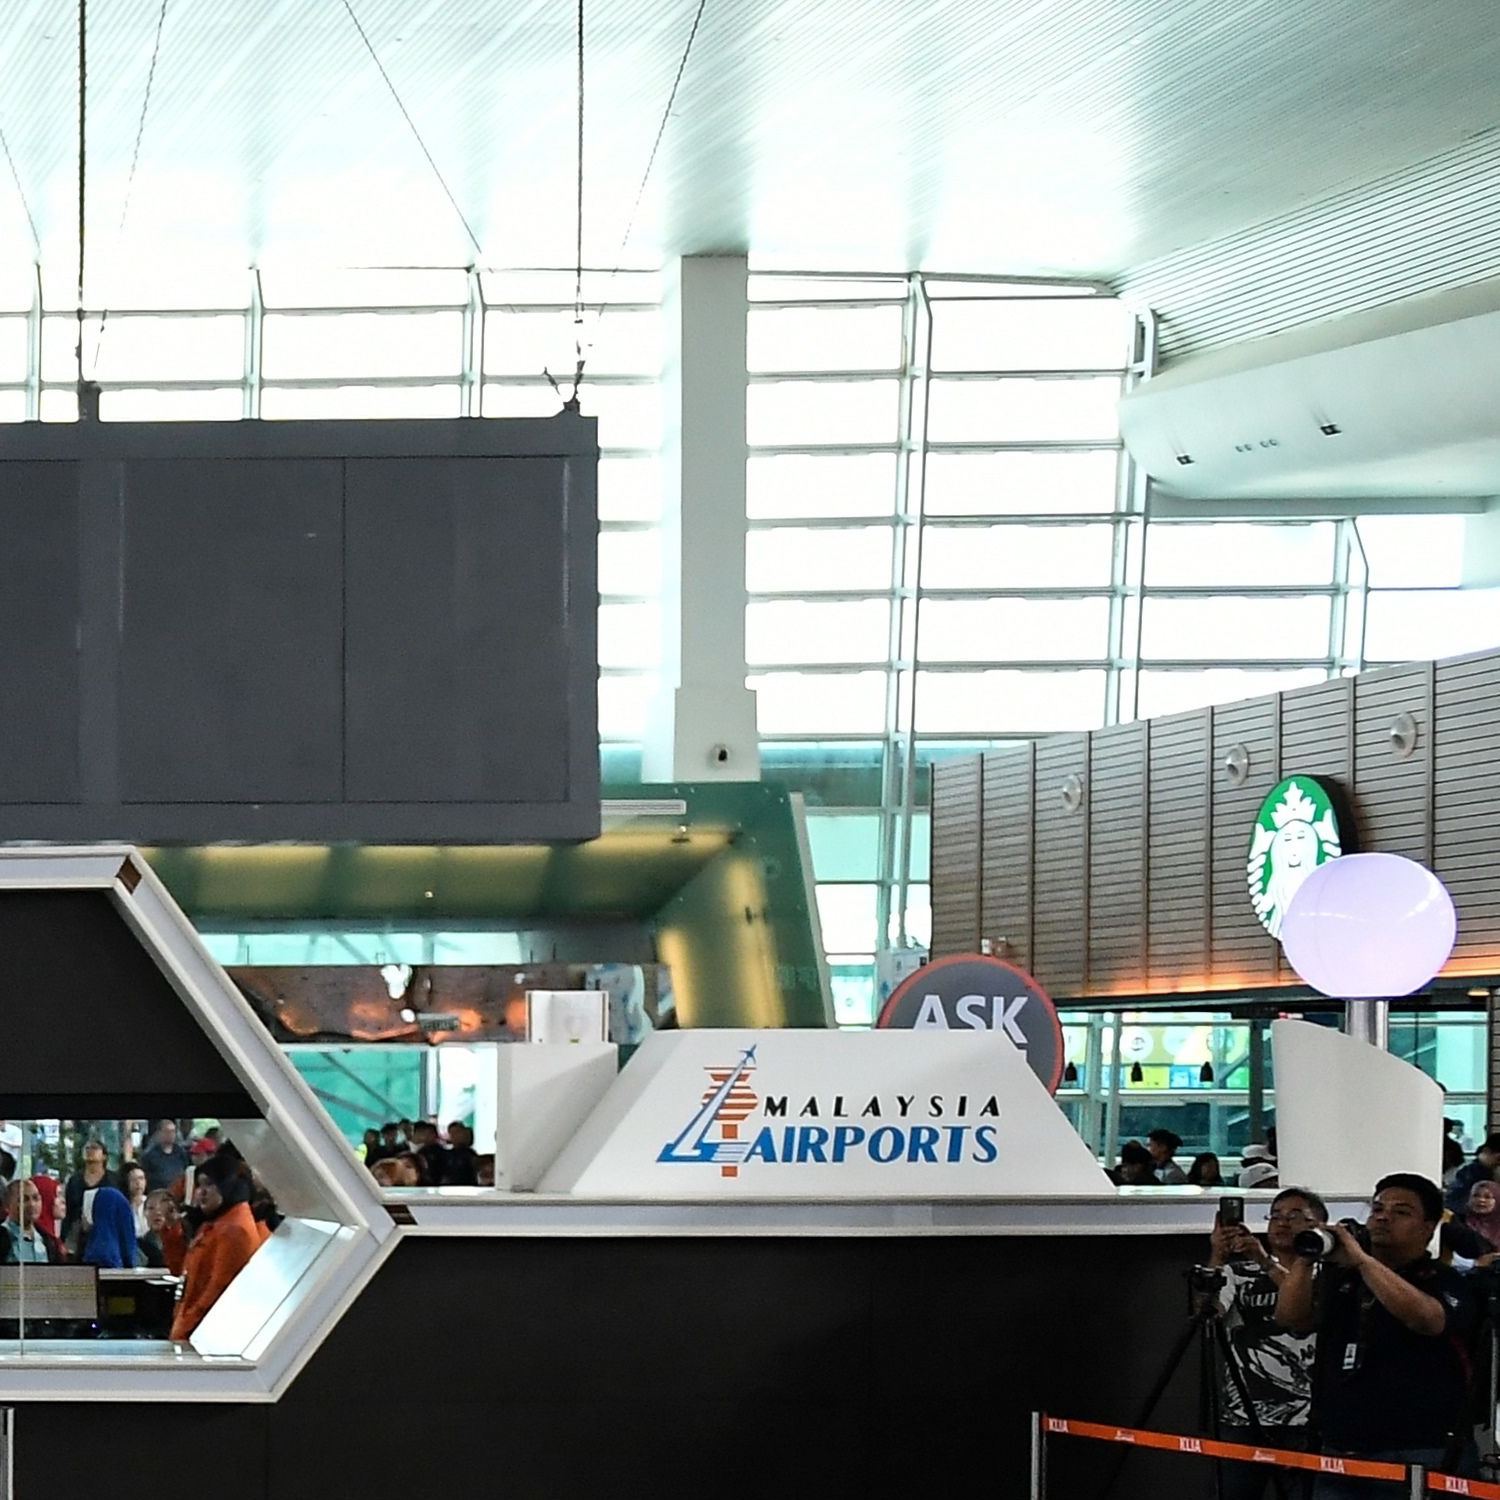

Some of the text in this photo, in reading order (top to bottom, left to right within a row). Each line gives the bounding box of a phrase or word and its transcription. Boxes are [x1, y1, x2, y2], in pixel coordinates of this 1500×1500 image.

[913, 994, 1028, 1044] ASK
[763, 1095, 1001, 1118] MALAYSIA
[743, 1125, 998, 1164] AIRPORTS
